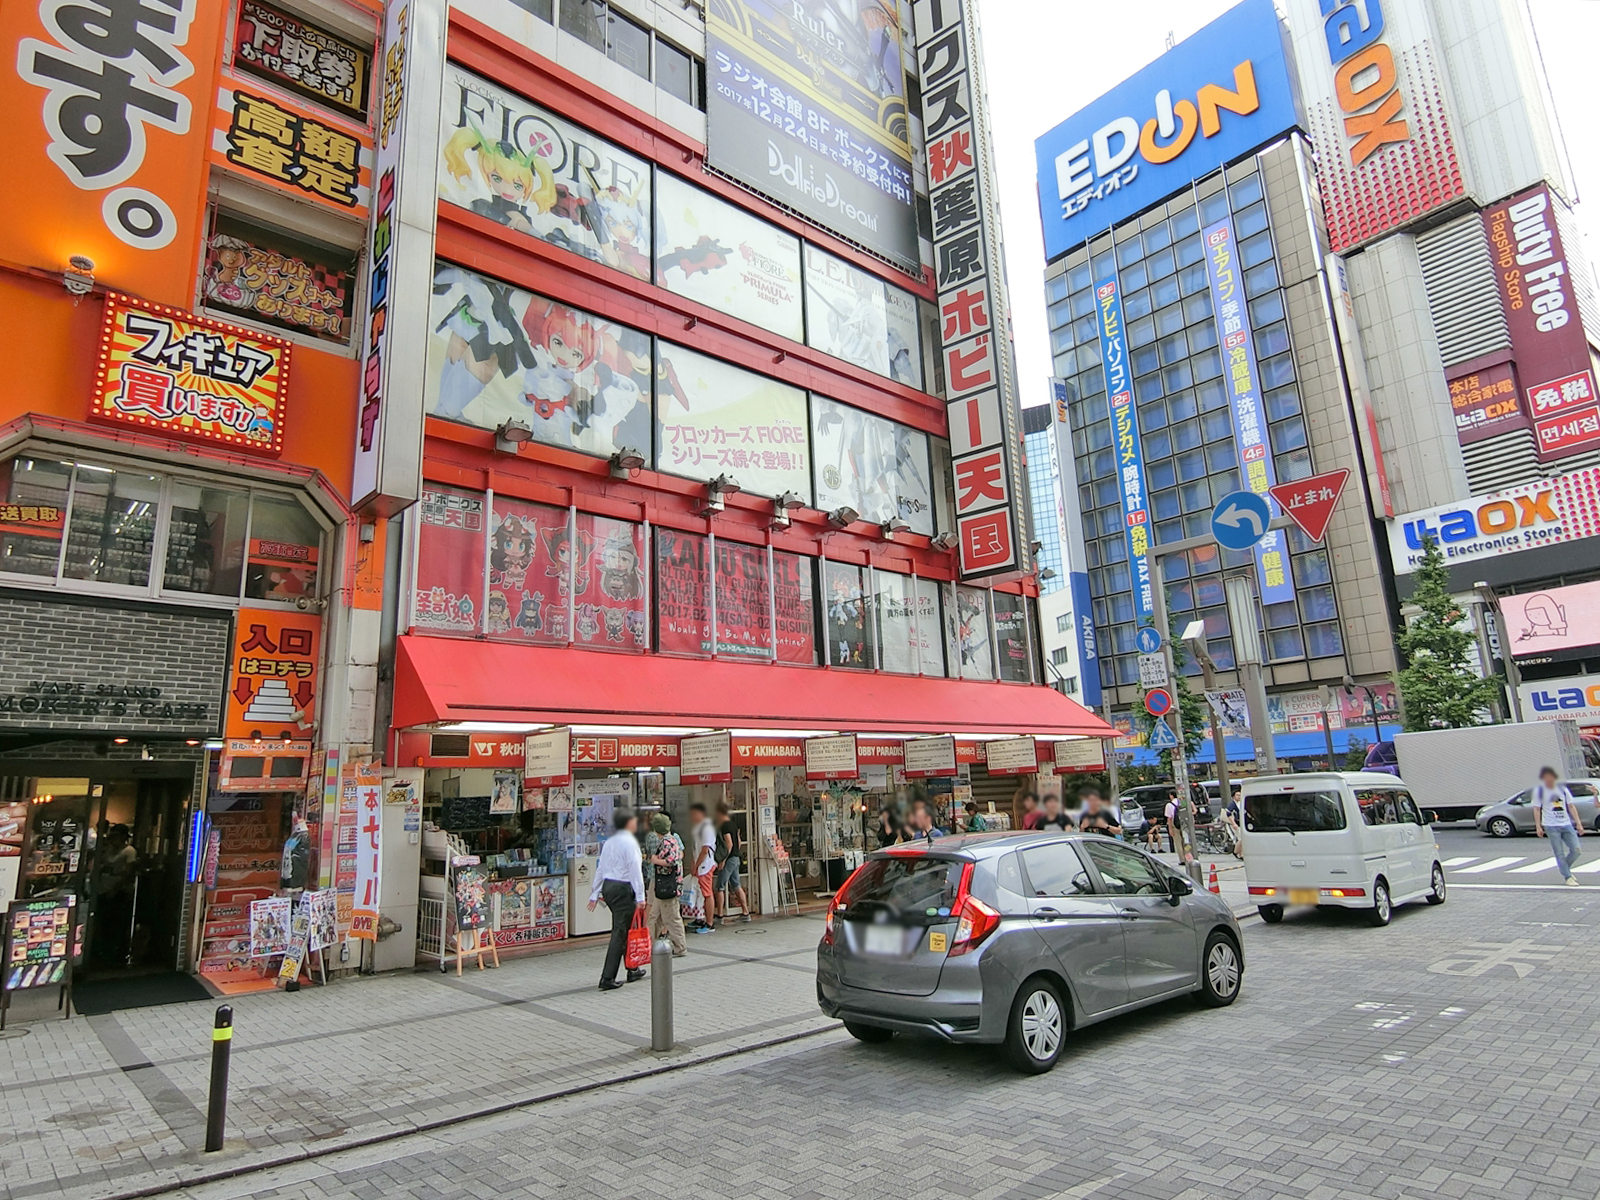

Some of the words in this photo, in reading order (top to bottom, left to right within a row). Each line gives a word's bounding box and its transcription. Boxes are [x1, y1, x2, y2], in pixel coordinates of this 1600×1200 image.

[791, 0, 845, 53] Ruler
[243, 14, 356, 88] 下取券
[715, 50, 804, 122] ラジオ会館
[806, 109, 831, 135] 8F
[236, 94, 358, 171] 高額
[452, 84, 640, 196] FIORE
[1055, 59, 1260, 200] EDION
[232, 131, 357, 205] 査定
[1061, 164, 1139, 220] エディオン
[1210, 230, 1228, 245] 6F
[1507, 191, 1556, 268] Duty
[249, 248, 311, 279] アダルト
[1489, 209, 1514, 269] Flagship
[1503, 268, 1524, 311] Store
[1099, 283, 1115, 298] 3F
[1212, 243, 1242, 335] エアコン・季節
[1524, 260, 1570, 334] Free
[128, 314, 272, 384] フィギュア
[1100, 295, 1126, 394] テレビ・パソコン
[1226, 333, 1245, 348] 5F
[1113, 392, 1129, 407] 2F
[1228, 346, 1262, 448] 冷蔵庫・洗濯機
[1449, 375, 1480, 395] 本店
[1451, 378, 1515, 410] 総合家電
[1534, 377, 1590, 411] 免税
[1504, 411, 1521, 420] Store
[1540, 414, 1600, 444] 면세점
[665, 424, 754, 445] ブロッカーズ
[756, 425, 805, 444] FIORE
[671, 445, 805, 471] シリーズ続々登場!!
[1115, 406, 1143, 512] デジカメ・腕時計
[1245, 446, 1264, 460] 4F
[1288, 486, 1336, 509] 止まれ
[1129, 511, 1145, 525] 1F
[1130, 525, 1149, 558] 免税
[1407, 551, 1444, 566] Hoe
[1446, 534, 1519, 558] Electronics
[1523, 525, 1563, 543] Store
[660, 565, 694, 582] ULTRA
[1136, 556, 1150, 583] TAX
[660, 576, 699, 595] KAIJU
[1141, 583, 1154, 612] FREE
[240, 623, 313, 656] 入口
[669, 622, 697, 636] Would
[725, 628, 739, 640] Be
[743, 631, 757, 645] My
[1081, 614, 1096, 660] AKIBA
[239, 657, 314, 678] はコチラ
[34, 680, 87, 696] VAPE
[97, 683, 162, 699] STAND
[138, 701, 209, 721] CAFE
[1537, 711, 1588, 722] AKIHABARA
[621, 743, 655, 757] HOBBY
[656, 744, 678, 757] 天国
[753, 745, 802, 757] AKIHABARA
